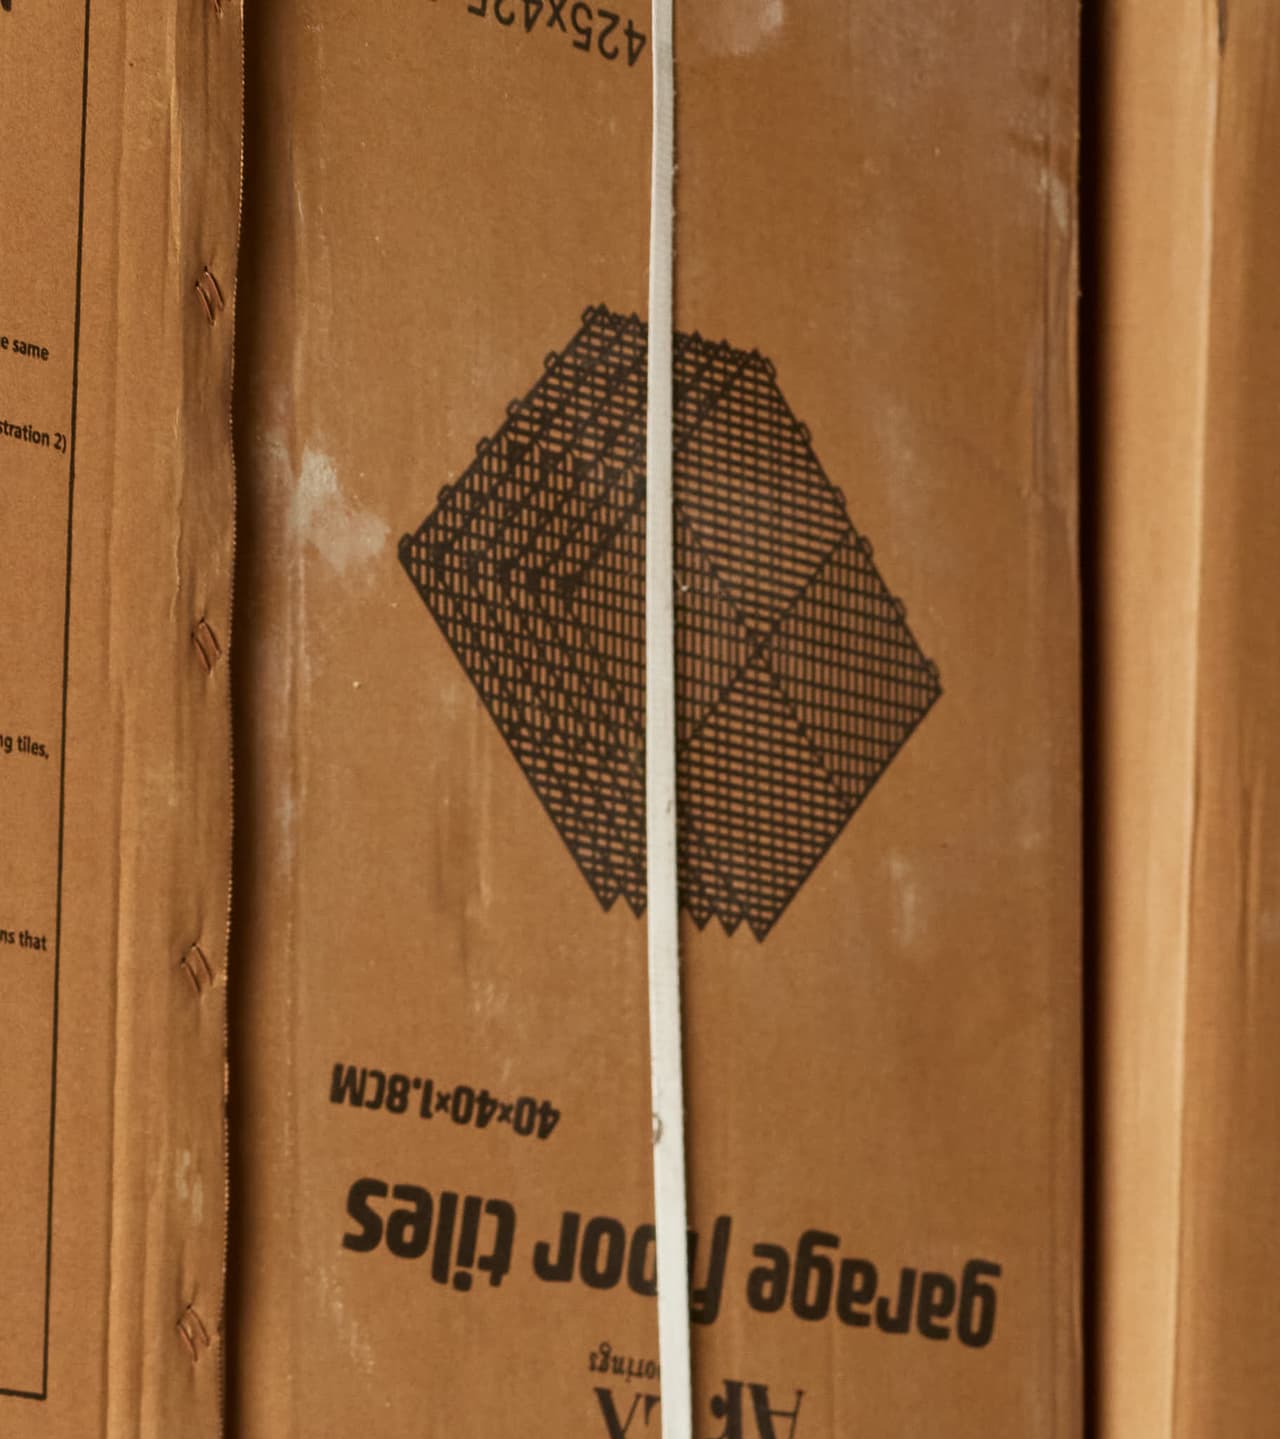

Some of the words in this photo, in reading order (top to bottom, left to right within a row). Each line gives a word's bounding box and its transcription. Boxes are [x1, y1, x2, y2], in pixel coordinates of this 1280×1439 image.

[13, 338, 49, 361] same
[54, 432, 67, 454] 2)
[17, 735, 49, 759] tiles,
[19, 929, 47, 951] that
[341, 1177, 516, 1292] tiles
[532, 1210, 731, 1325] foor
[745, 1228, 1002, 1350] garage
[589, 1342, 662, 1383] orings
